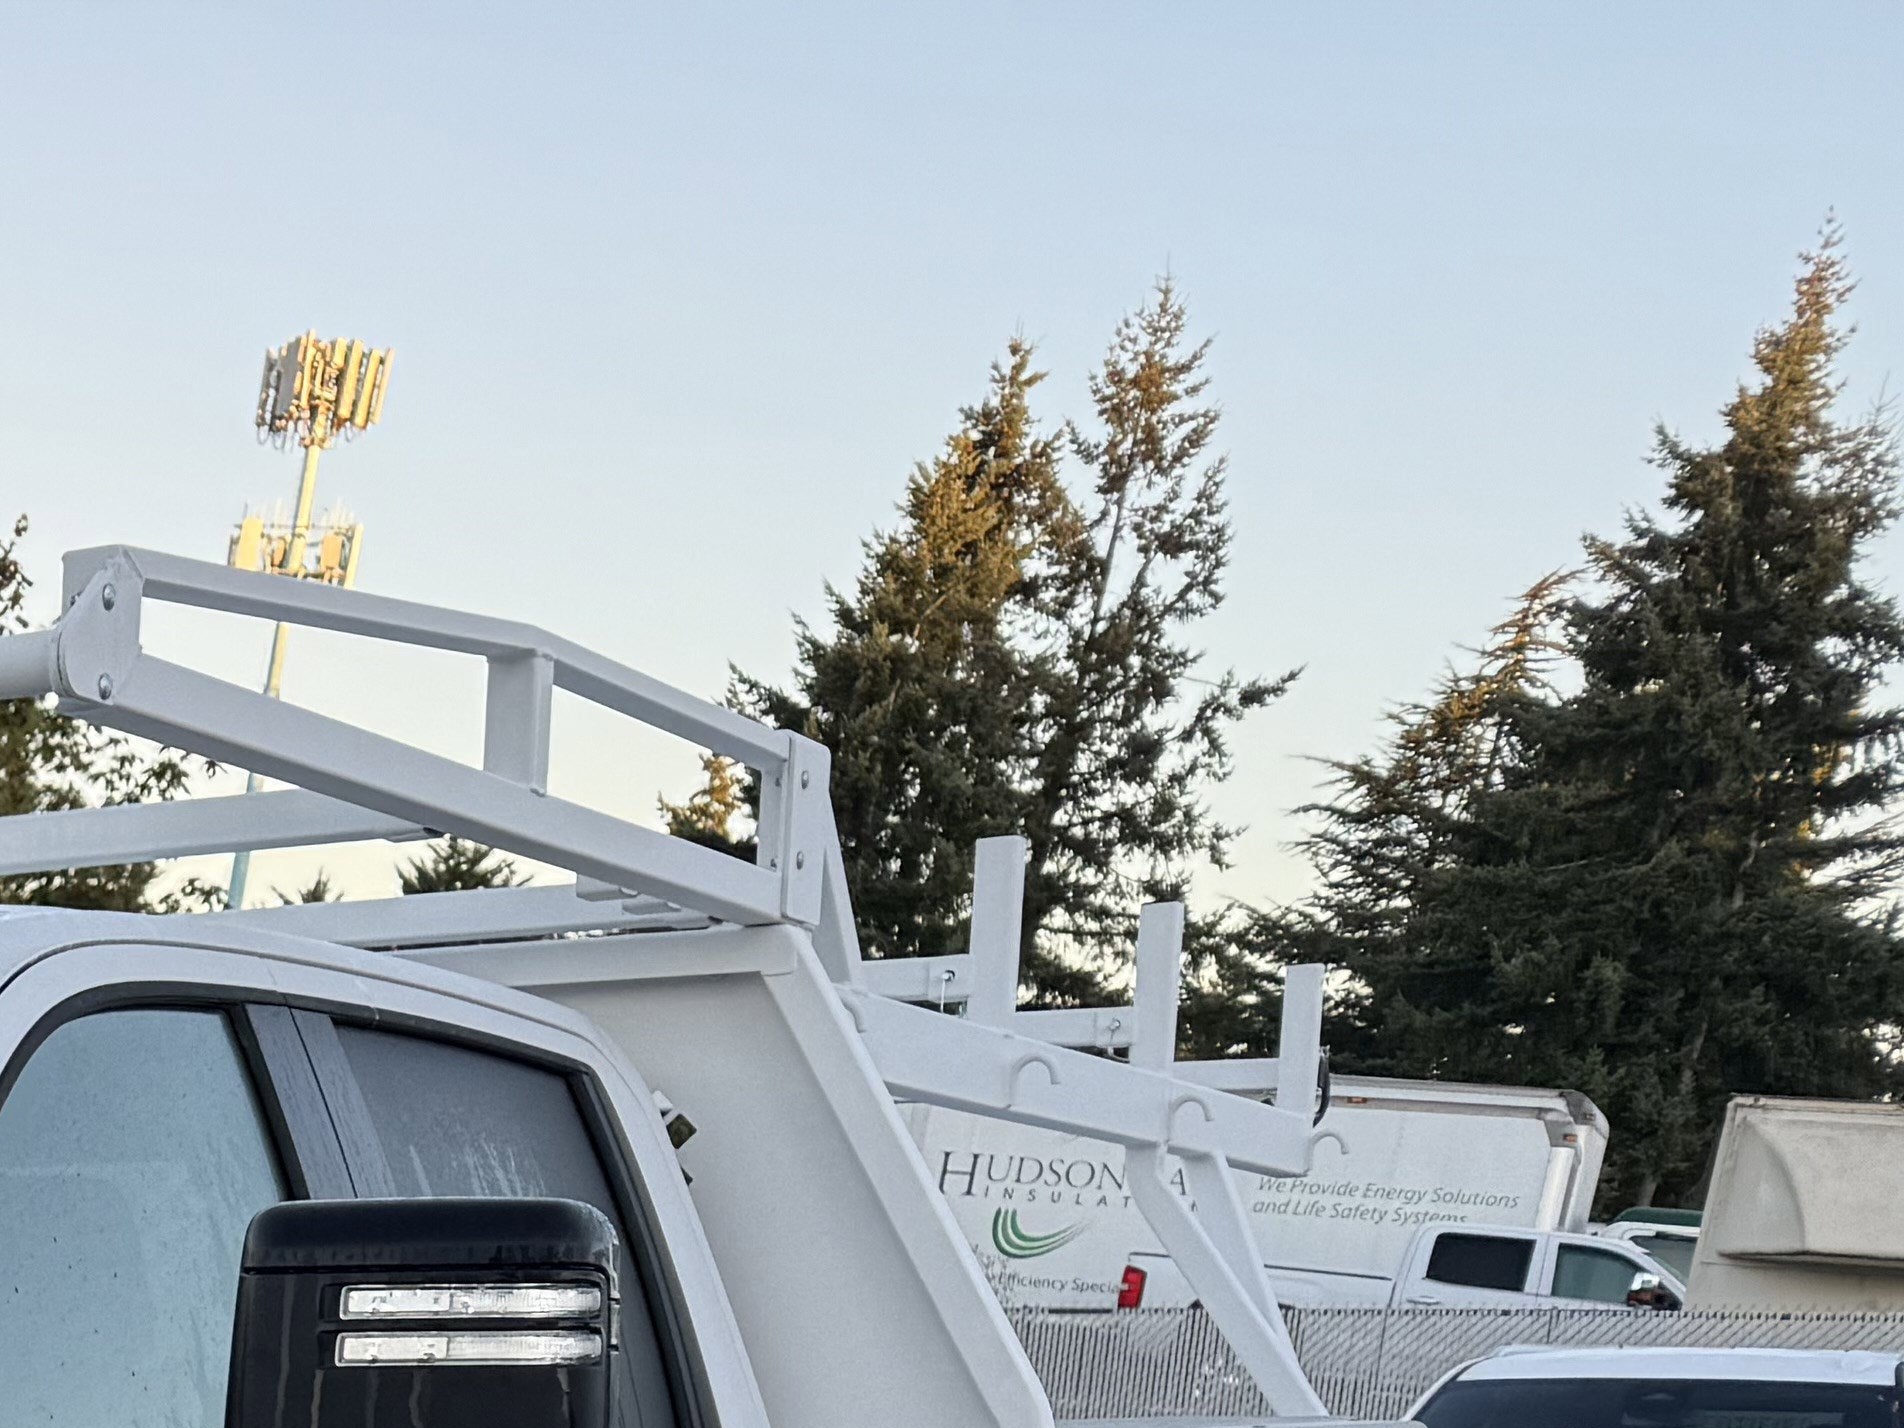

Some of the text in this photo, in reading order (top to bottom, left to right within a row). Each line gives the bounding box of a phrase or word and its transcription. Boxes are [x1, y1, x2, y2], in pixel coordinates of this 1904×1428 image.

[939, 1150, 1127, 1196] HUDSON
[1258, 1176, 1521, 1209] We Provide Energy Solutions
[1252, 1197, 1291, 1215] and
[1292, 1202, 1327, 1218] Life
[1329, 1203, 1389, 1225] Safety
